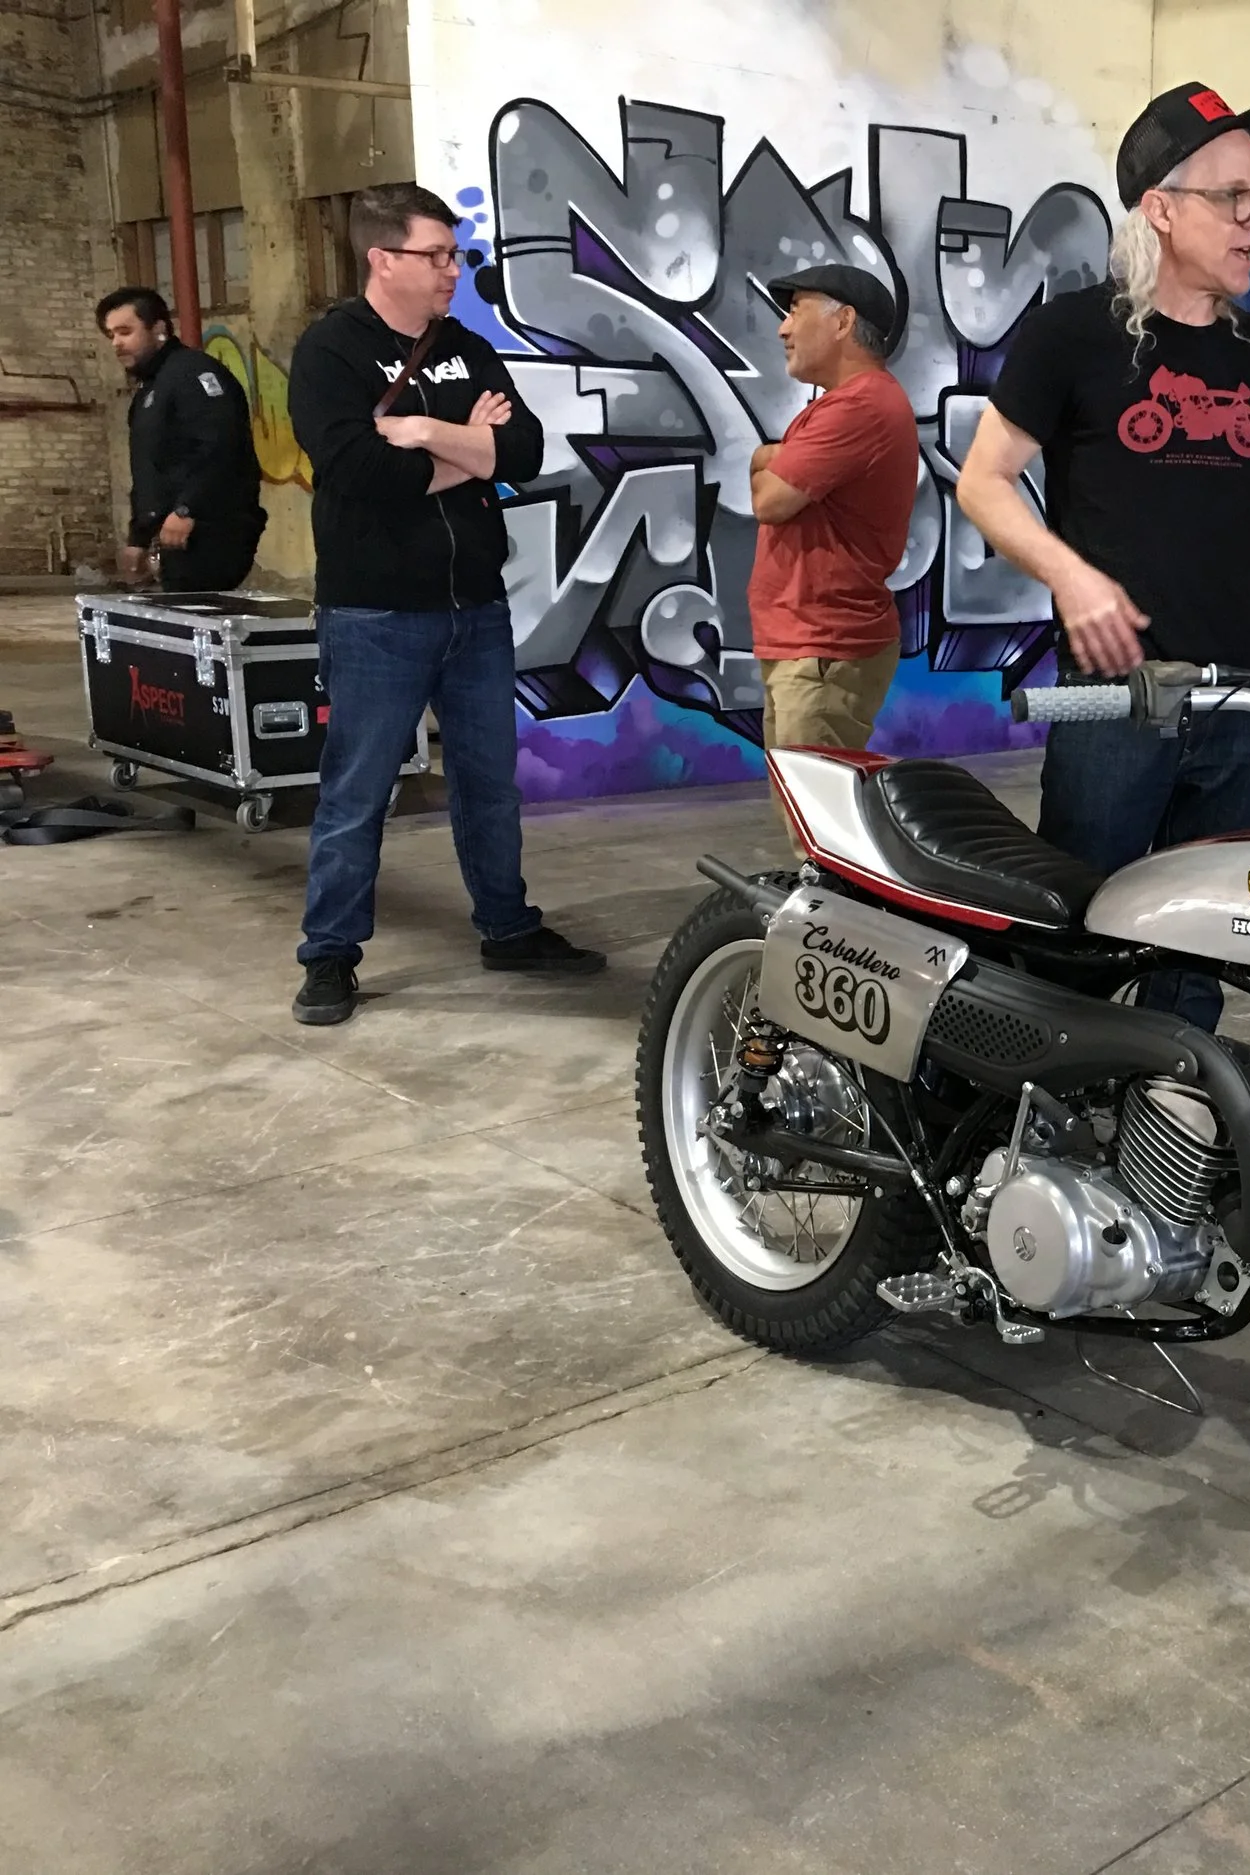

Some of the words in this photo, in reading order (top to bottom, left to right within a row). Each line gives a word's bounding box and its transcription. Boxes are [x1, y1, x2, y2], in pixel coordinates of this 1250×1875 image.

[129, 664, 185, 720] ASPECT
[803, 921, 901, 980] Caballero
[795, 953, 891, 1046] 360
